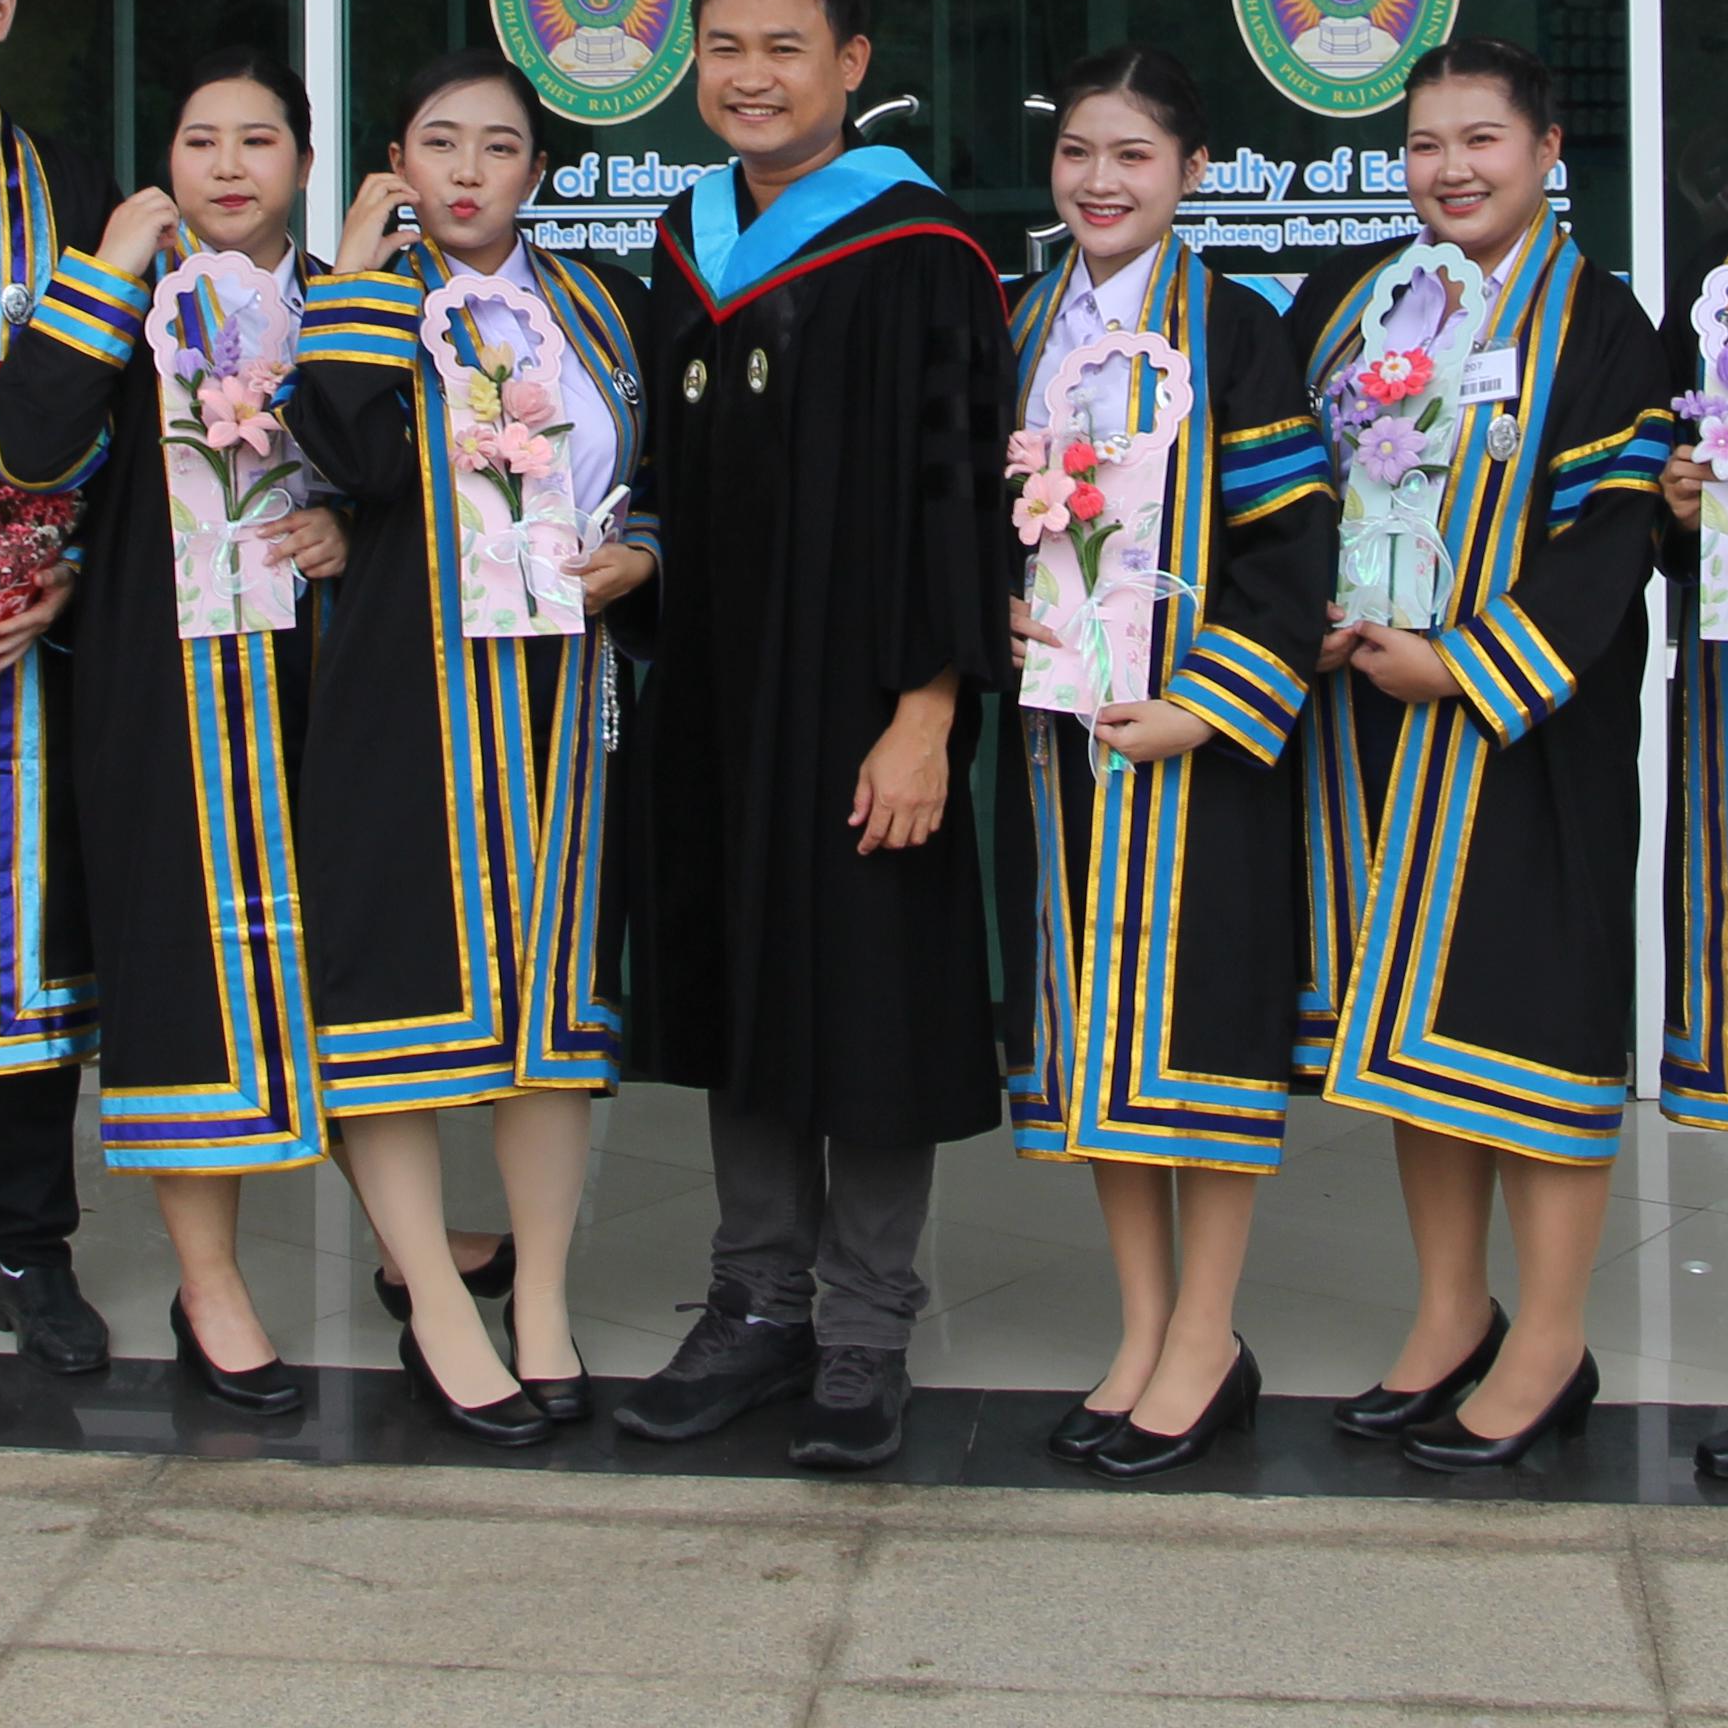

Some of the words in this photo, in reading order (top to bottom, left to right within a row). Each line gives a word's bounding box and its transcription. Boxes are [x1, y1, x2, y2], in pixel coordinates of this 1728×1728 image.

[537, 73, 578, 106] PHET
[587, 62, 673, 114] RAJABHAT
[1279, 64, 1321, 97] PHET
[553, 152, 600, 198] of
[1199, 147, 1296, 202] culty
[1303, 145, 1354, 193] of
[536, 220, 587, 249] Phet
[589, 221, 658, 255] Rajab
[1174, 217, 1283, 253] mphaeng
[1285, 216, 1339, 246] Phet
